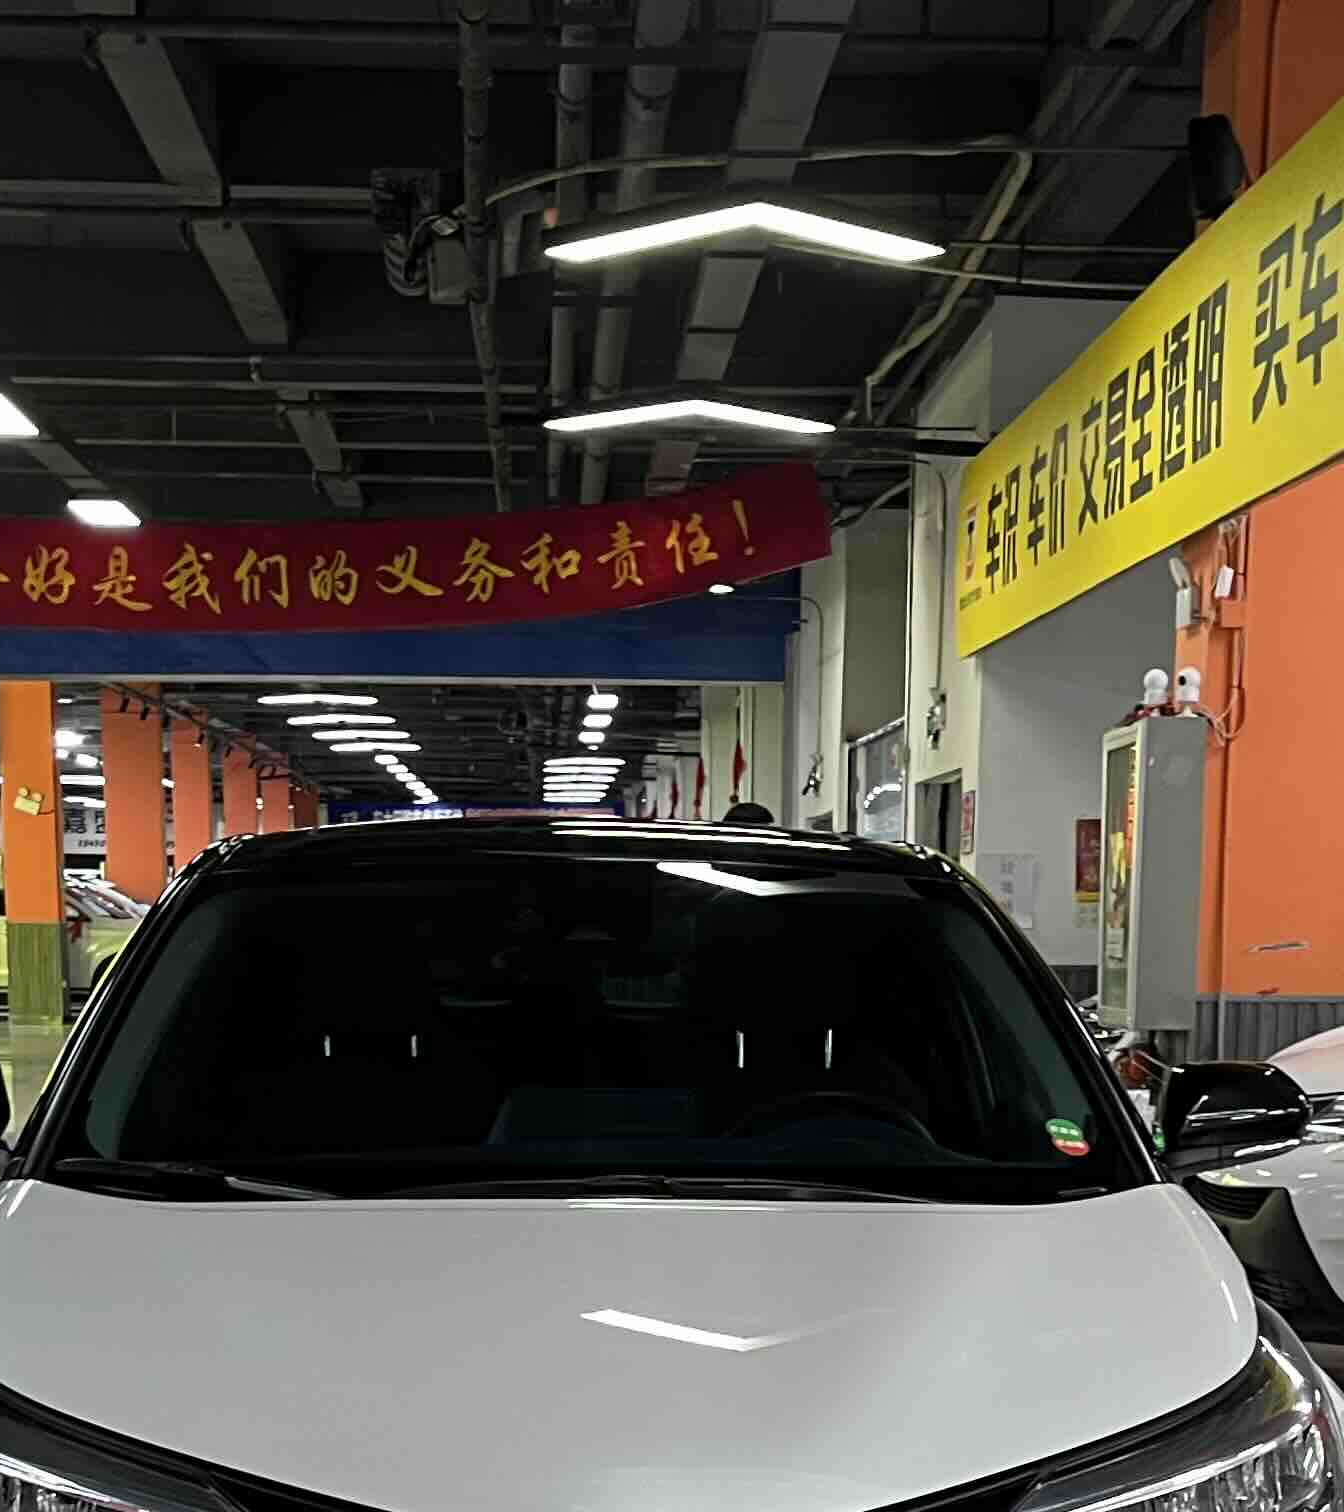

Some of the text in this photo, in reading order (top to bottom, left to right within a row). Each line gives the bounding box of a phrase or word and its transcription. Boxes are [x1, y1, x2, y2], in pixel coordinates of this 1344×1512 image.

[985, 464, 1021, 594] 车况
[1027, 423, 1069, 566] 车价
[1078, 279, 1229, 537] 交易全透明
